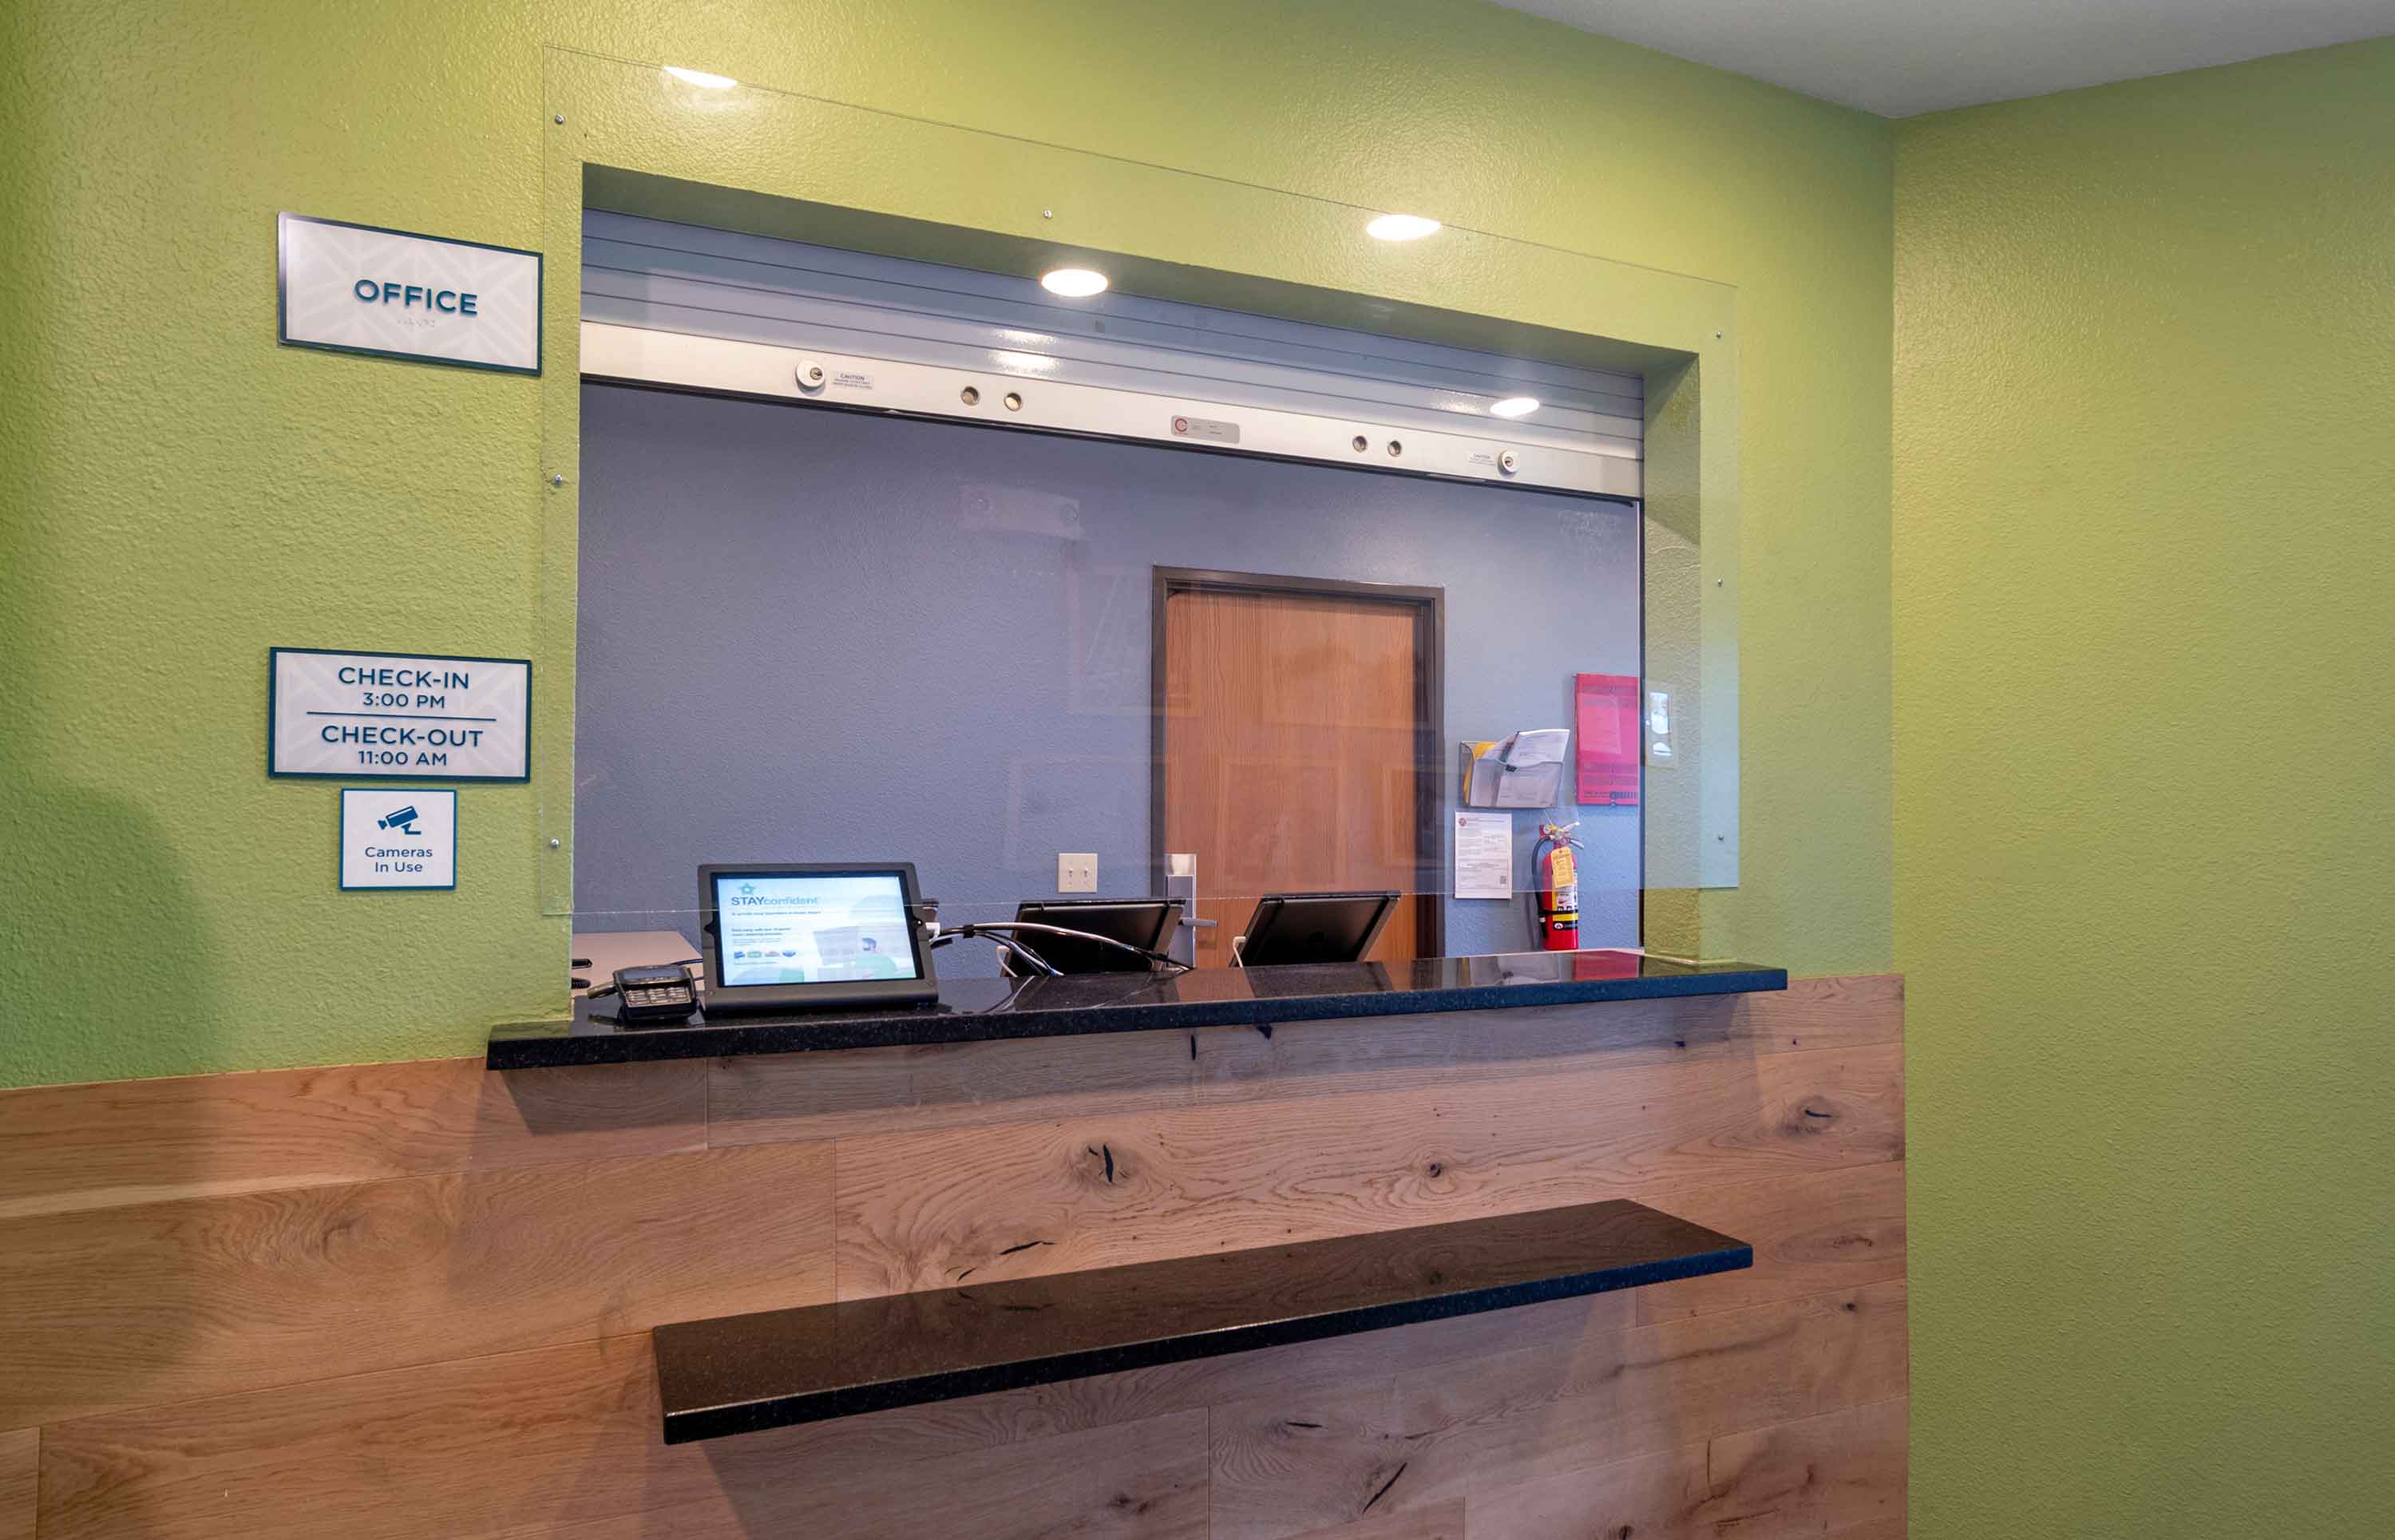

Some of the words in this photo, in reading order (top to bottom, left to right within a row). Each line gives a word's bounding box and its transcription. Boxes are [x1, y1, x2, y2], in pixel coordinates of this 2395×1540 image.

[354, 279, 478, 316] OFFICE
[338, 667, 469, 689] CHECK-IN
[362, 692, 409, 708] 3:00
[417, 695, 445, 708] PM
[321, 725, 484, 747] CHECK-OUT
[358, 750, 409, 766] 11:00
[415, 753, 447, 766] AM
[364, 846, 433, 857] Cameras
[374, 861, 389, 873] In
[394, 862, 423, 873] Use
